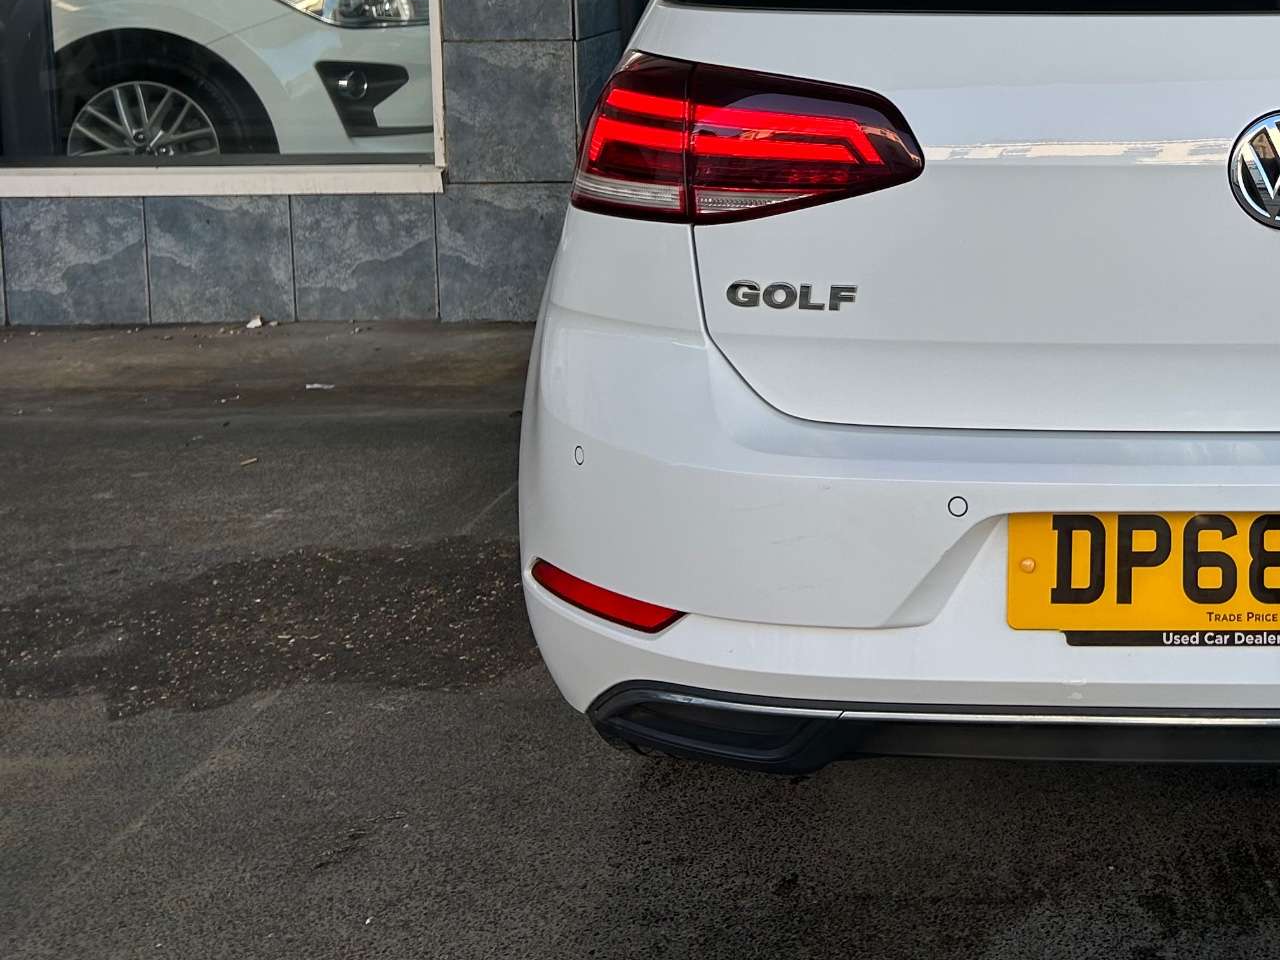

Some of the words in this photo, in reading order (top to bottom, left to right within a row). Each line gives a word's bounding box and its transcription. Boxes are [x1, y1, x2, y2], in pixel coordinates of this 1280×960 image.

[726, 279, 858, 311] GOLF
[1162, 632, 1199, 645] Used
[1204, 632, 1230, 645] Car
